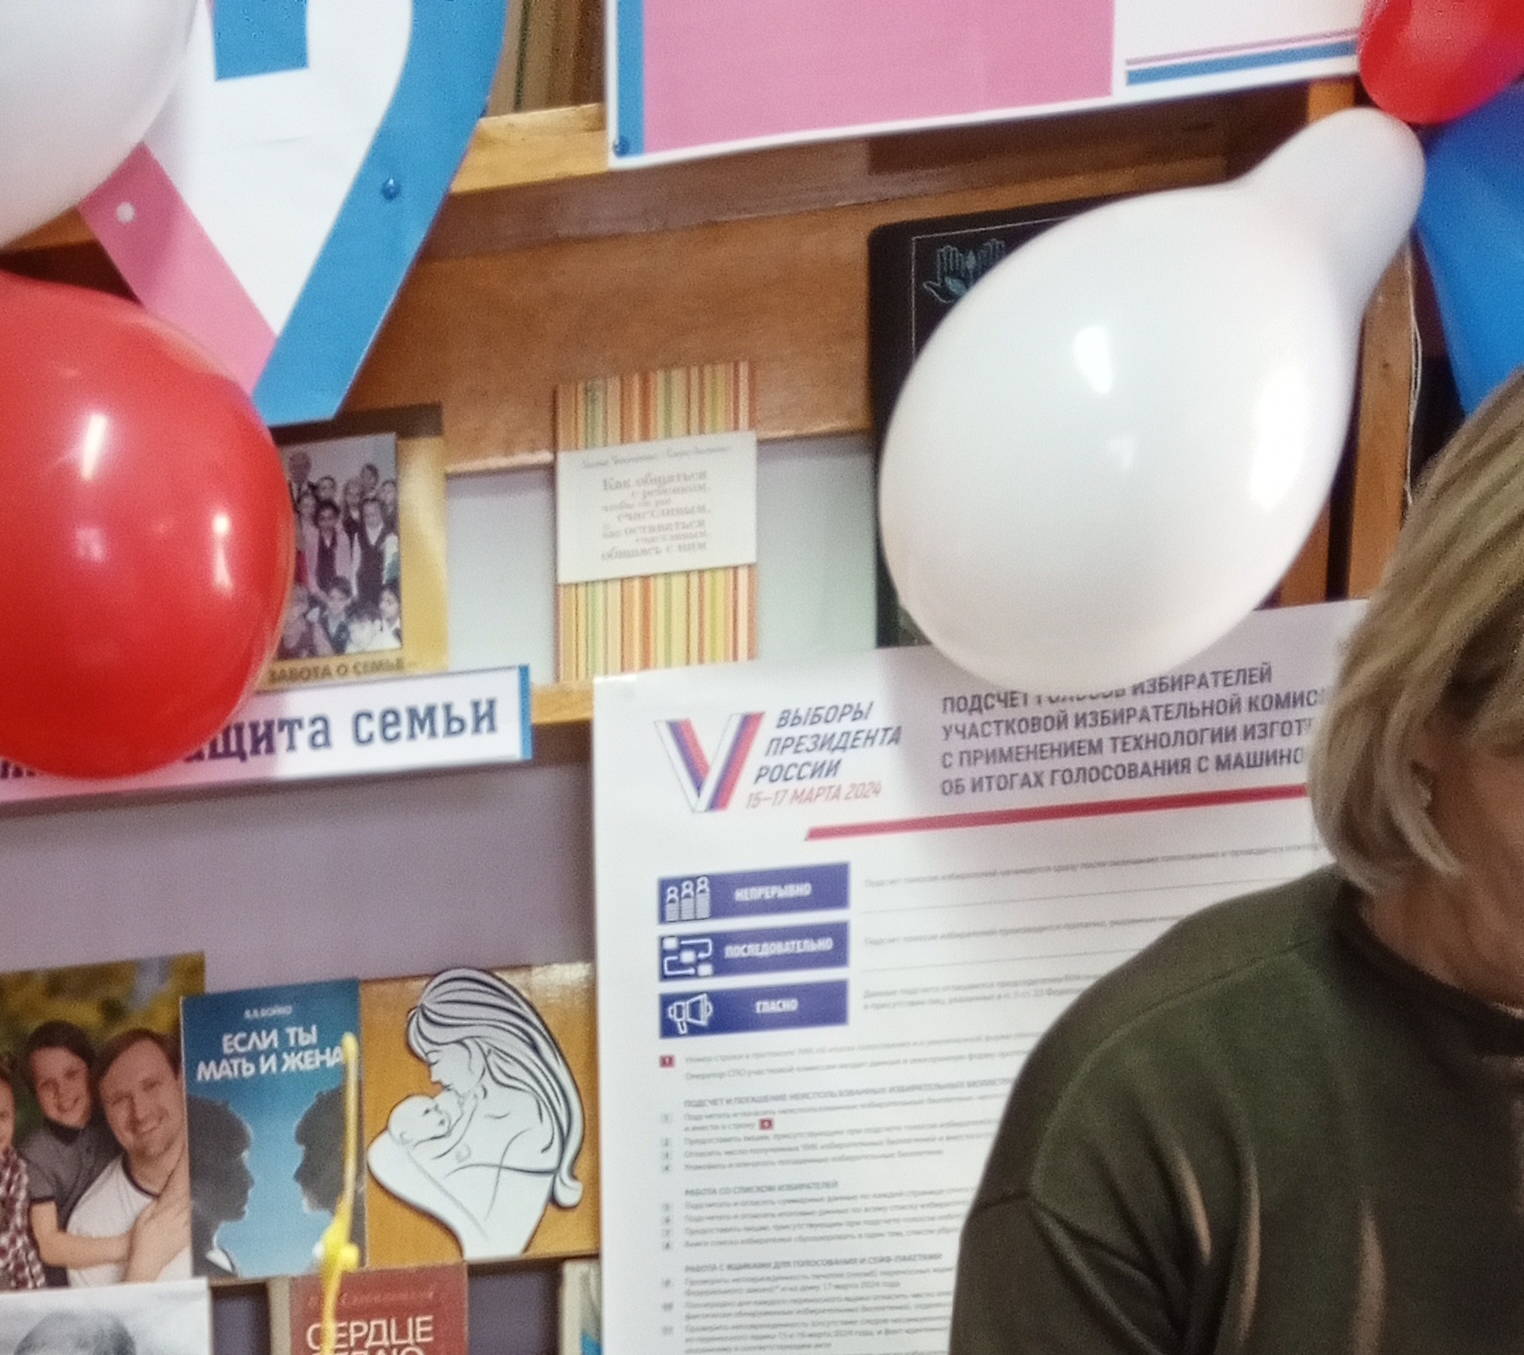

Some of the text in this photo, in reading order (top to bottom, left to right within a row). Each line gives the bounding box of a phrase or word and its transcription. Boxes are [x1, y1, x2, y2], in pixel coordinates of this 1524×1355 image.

[602, 470, 707, 491] Как общаться
[268, 666, 332, 685] ЗАБОТА
[336, 664, 349, 677] О
[1132, 662, 1273, 697] ИЗБИРАТЕЛЕЙ
[350, 697, 499, 747] семьи
[776, 700, 875, 729] ВЫБОРЫ
[942, 710, 1069, 742] УЧАСТКОВОЙ
[1076, 694, 1242, 729] ИЗБИРАТЕЛЬНОЙ
[765, 725, 903, 757] ПРЕЗИДЕНТА
[941, 752, 953, 769] С
[959, 738, 1103, 767] ПРИМЕНЕНИЕМ
[1110, 726, 1237, 755] ТЕХНОЛОГИИ
[753, 758, 843, 784] РОССИИ
[941, 778, 966, 797] ОБ
[971, 770, 1044, 794] ИТОГАХ
[1050, 758, 1192, 786] ГОЛОСОВАНИЯ
[1197, 756, 1210, 773] С
[790, 783, 843, 804] МАРТА
[844, 780, 883, 800] 2024
[734, 882, 813, 902] НЕПРЕРЫВНО
[724, 937, 834, 959] ПОСЛЕДОВАТЕЛЬНО
[755, 998, 799, 1013] ГЛАСНО
[222, 1024, 317, 1055] ЕСЛИ ТЫ
[196, 1045, 345, 1082] МАТЬ И ЖЕНА
[306, 1315, 434, 1351] СЕРДЦЕ
